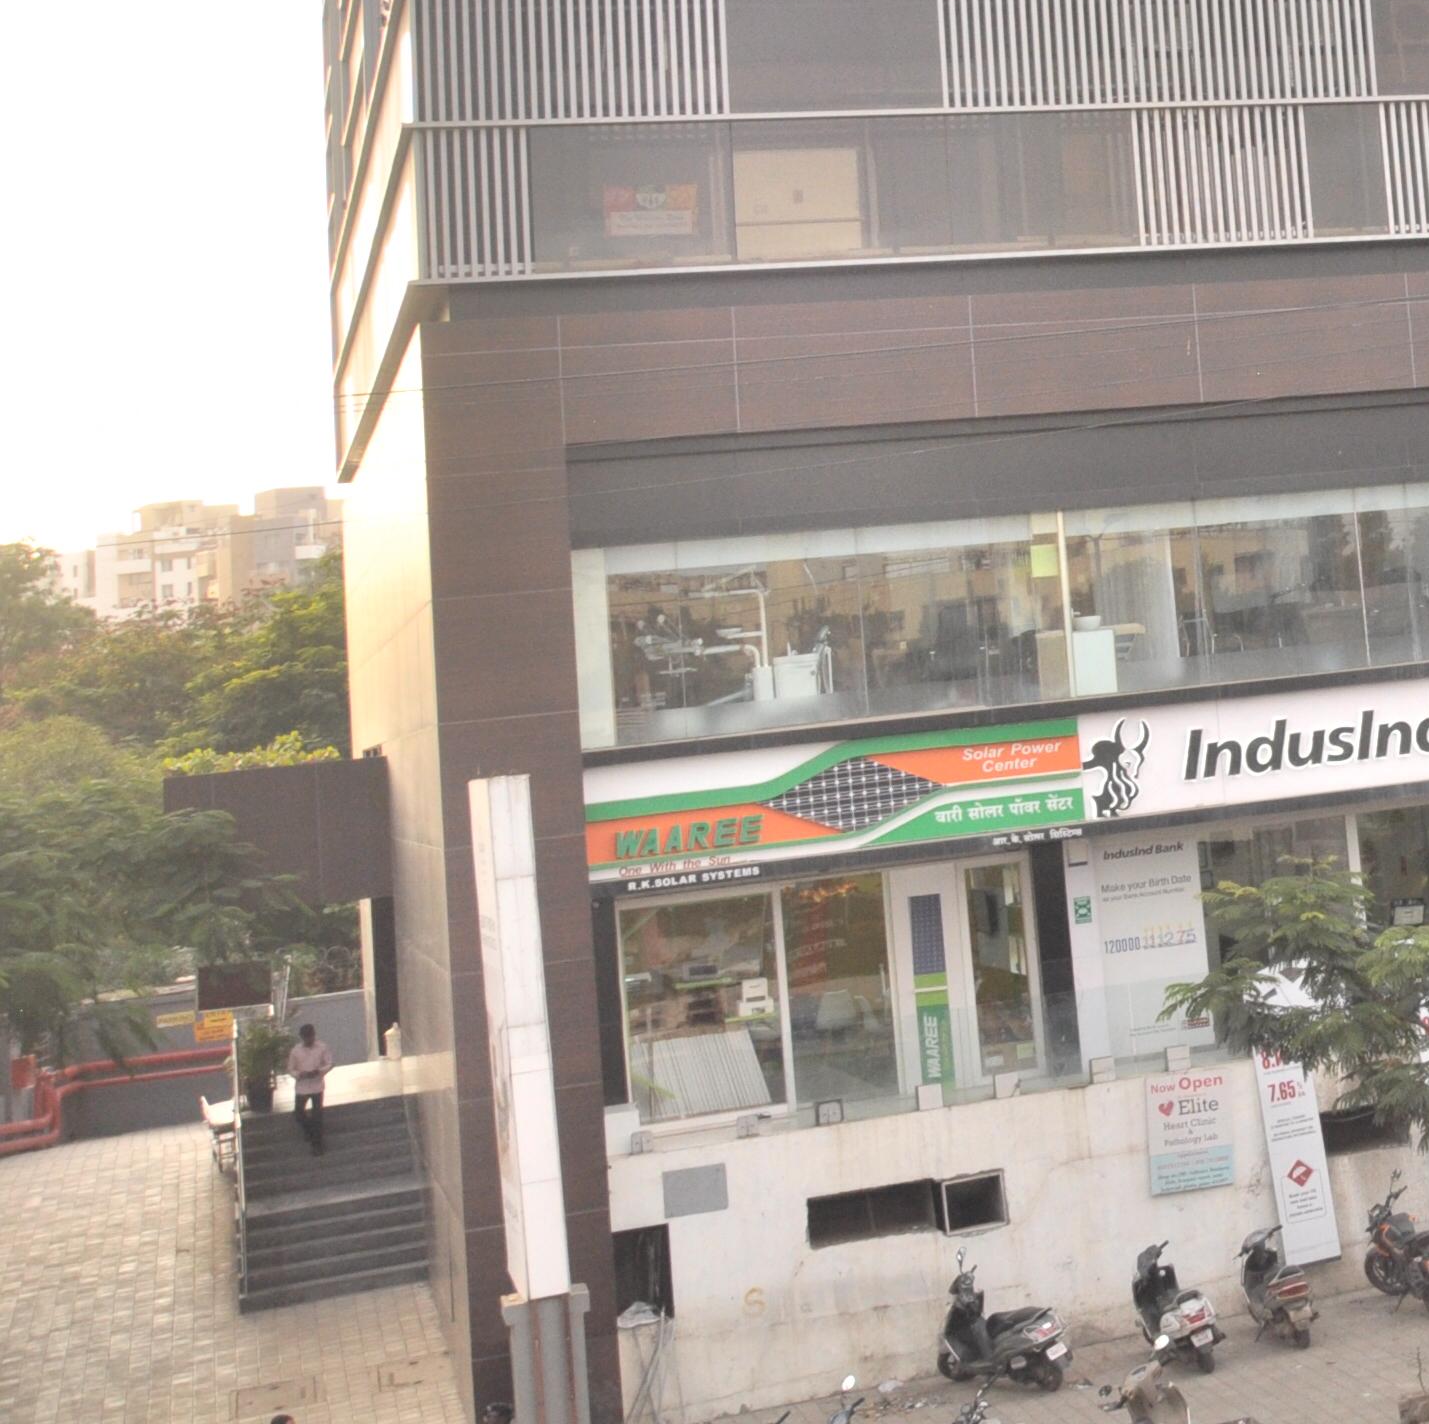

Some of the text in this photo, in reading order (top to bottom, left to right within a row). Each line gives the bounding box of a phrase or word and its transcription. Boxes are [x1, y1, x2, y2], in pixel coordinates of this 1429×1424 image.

[962, 741, 1062, 761] Solar Power
[982, 757, 1037, 773] Center
[614, 814, 765, 860] WAAREE
[1103, 841, 1184, 861] IndusInd Bank
[619, 855, 731, 877] One With the Sun
[702, 866, 760, 882] SYSTEMS
[1151, 1075, 1223, 1094] Now Open
[1267, 1080, 1296, 1102] 7.65
[1178, 1098, 1219, 1115] Elite
